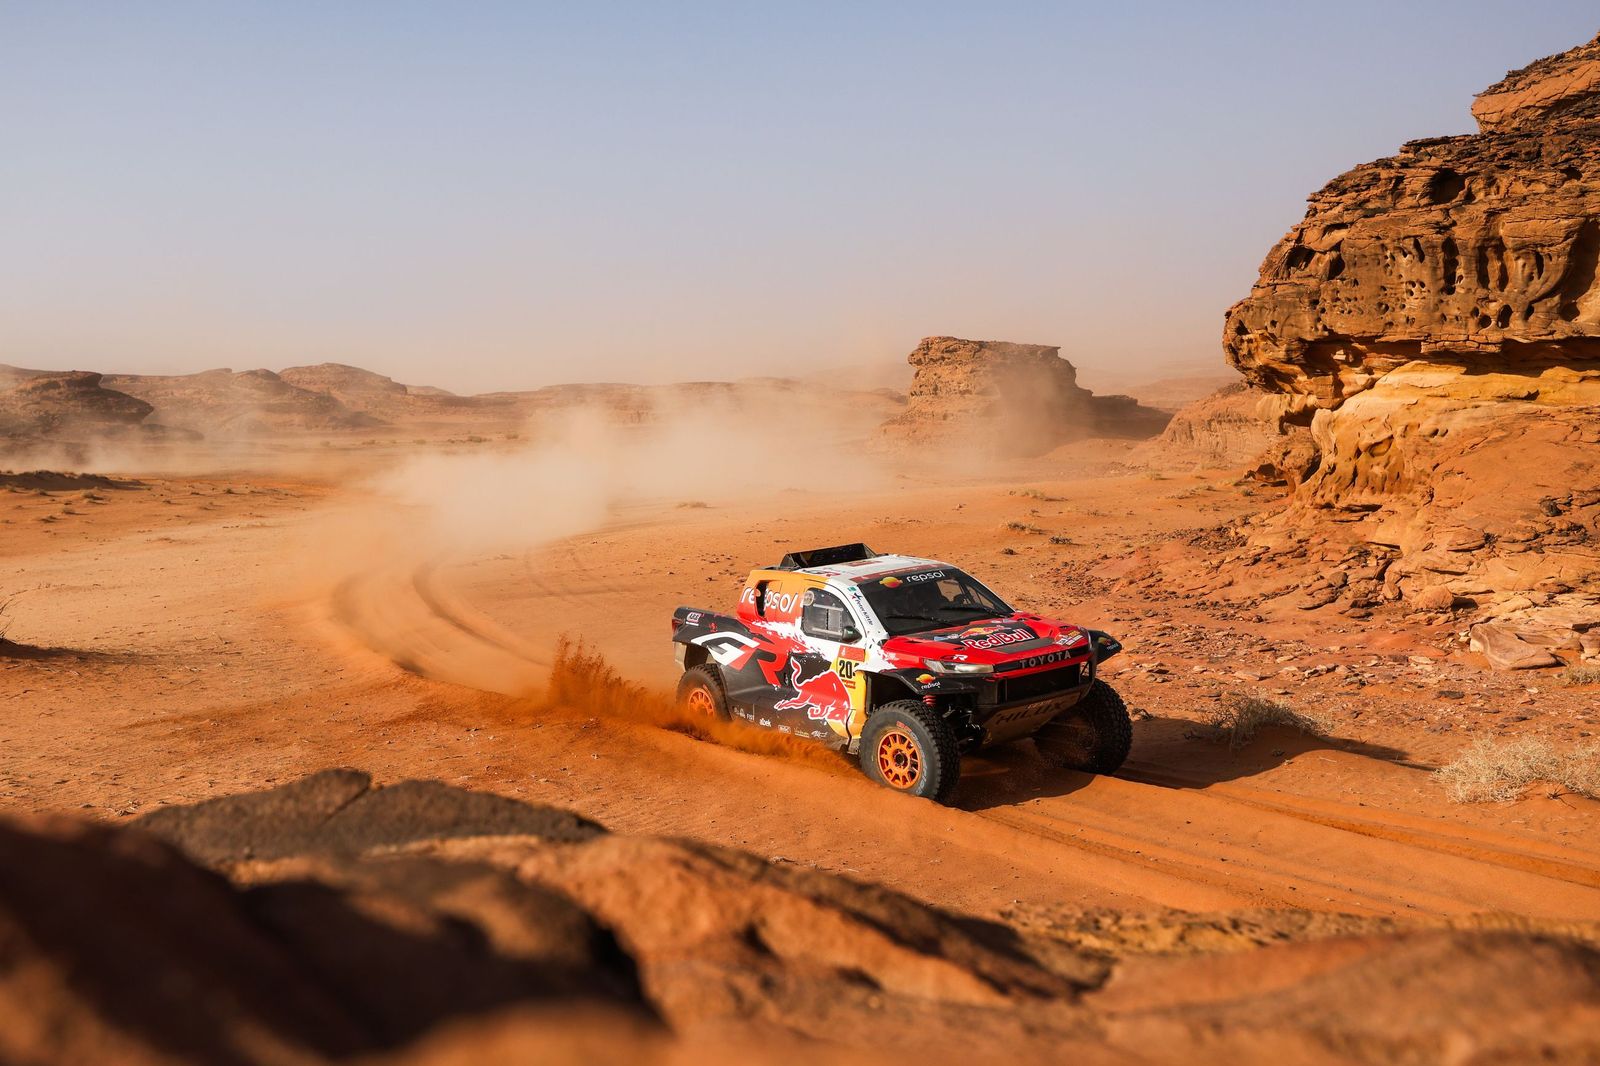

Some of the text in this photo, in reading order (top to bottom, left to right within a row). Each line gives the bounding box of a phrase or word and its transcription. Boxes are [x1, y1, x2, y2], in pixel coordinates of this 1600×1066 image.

[906, 570, 945, 583] repsol
[740, 586, 799, 614] repsol
[960, 634, 1005, 650] Red
[993, 628, 1035, 646] Bull
[1019, 650, 1072, 669] TOYOTA
[920, 681, 941, 690] repsol
